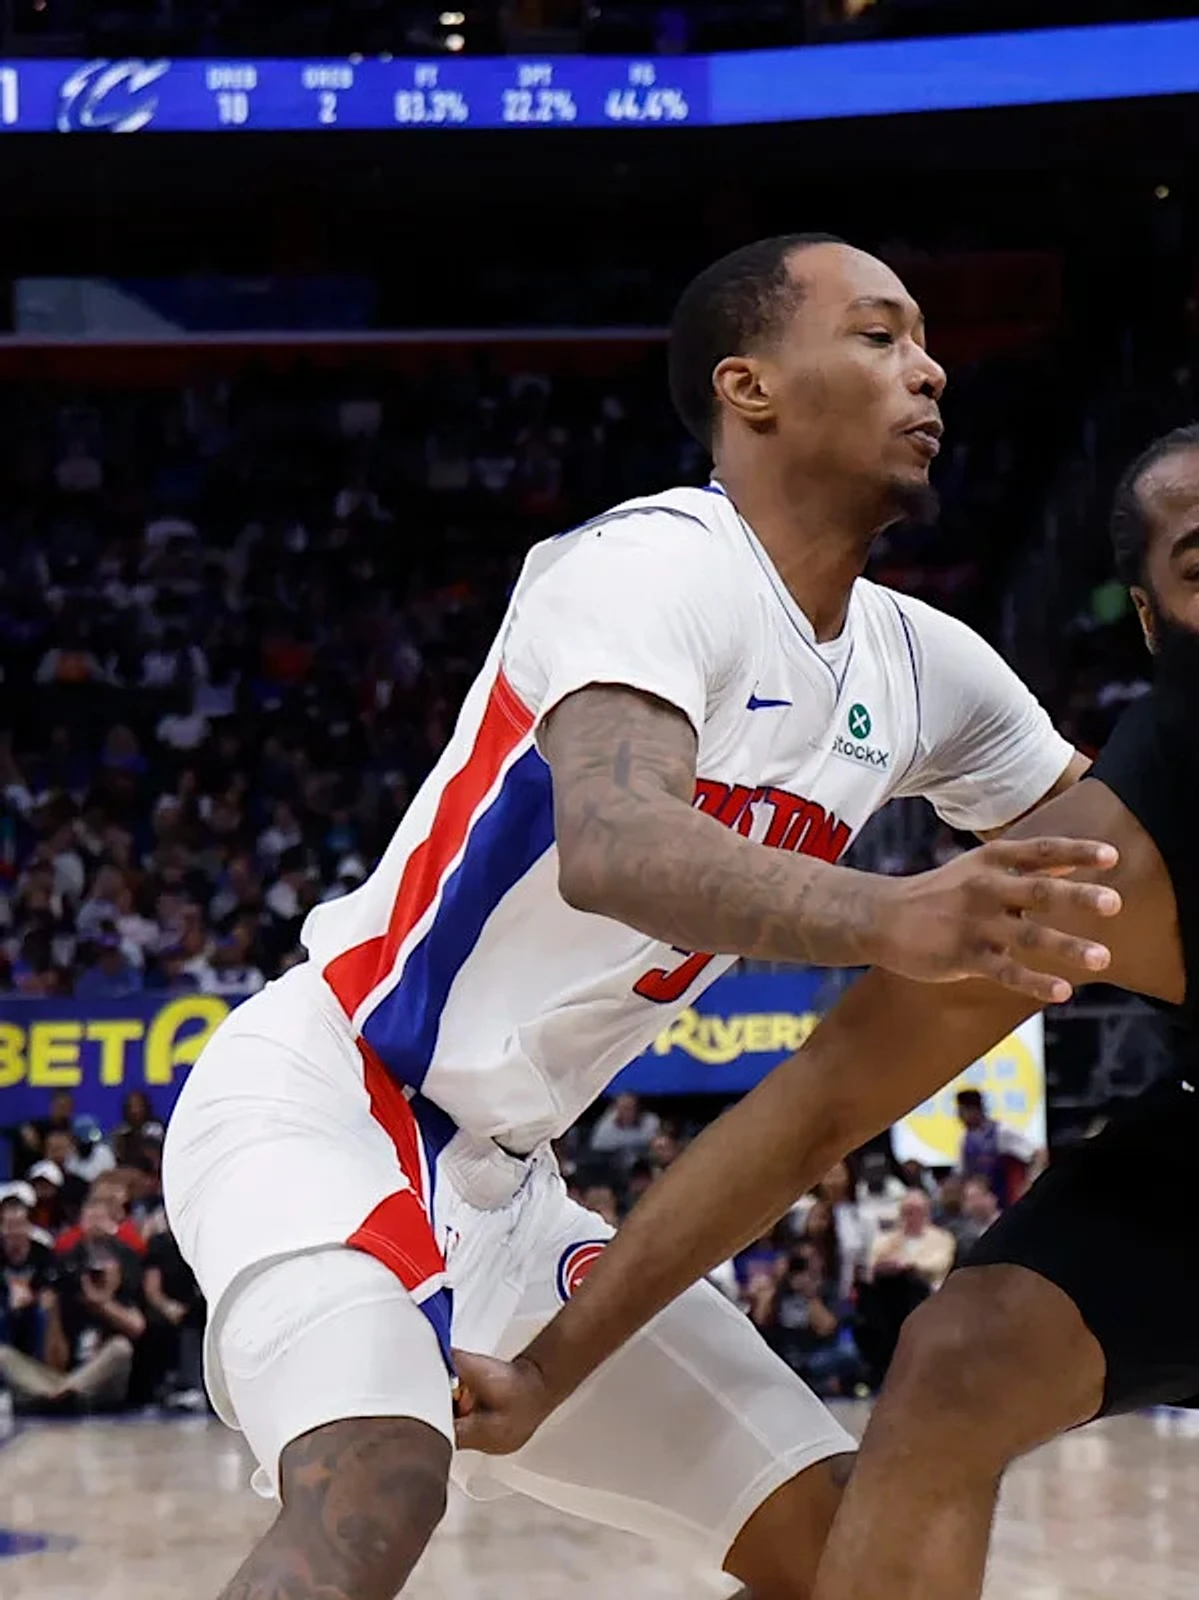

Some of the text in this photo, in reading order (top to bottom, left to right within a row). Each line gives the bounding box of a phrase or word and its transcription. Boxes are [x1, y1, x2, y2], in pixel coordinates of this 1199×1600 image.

[217, 91, 249, 124] 10
[319, 91, 338, 124] 2
[502, 89, 577, 122] 22.2%
